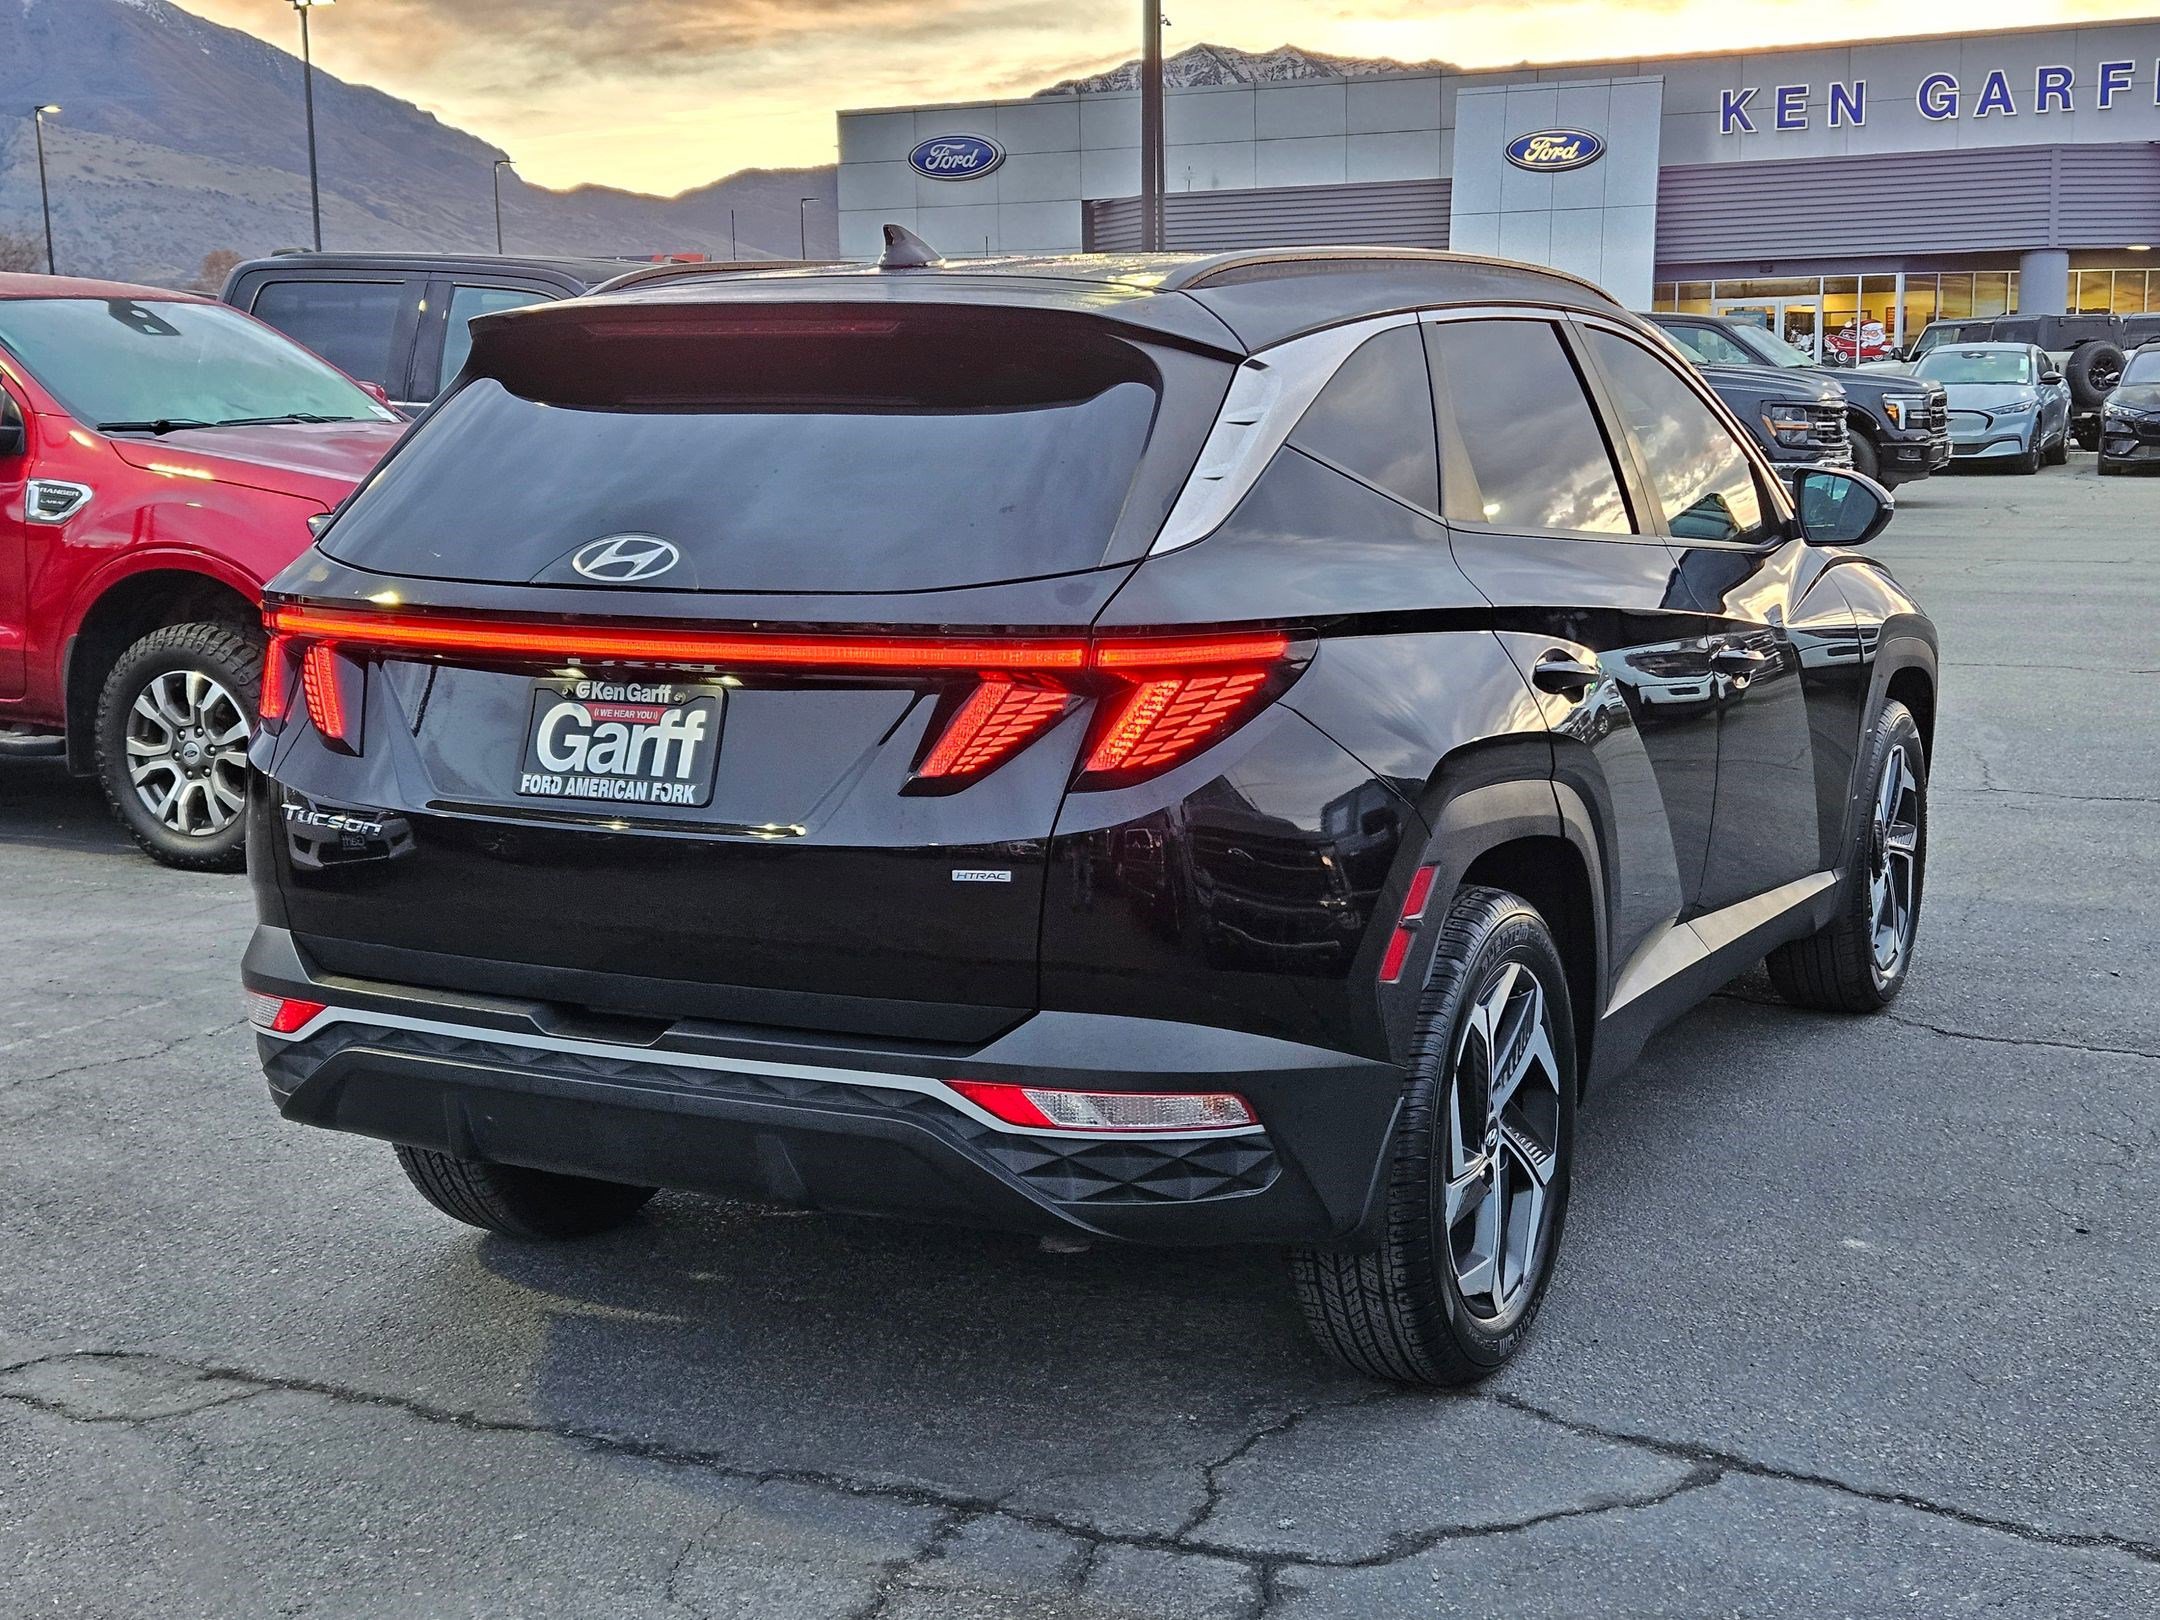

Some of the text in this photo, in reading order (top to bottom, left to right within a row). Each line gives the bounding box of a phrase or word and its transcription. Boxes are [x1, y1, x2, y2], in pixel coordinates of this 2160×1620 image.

[1719, 79, 1868, 135] KEN
[925, 143, 979, 170] Ford
[1523, 136, 1581, 161] Ford
[40, 486, 80, 497] RANGER
[591, 681, 625, 701] Ken
[626, 683, 672, 704] Garff
[600, 709, 654, 720] WE HEAR YOU
[536, 702, 706, 779] Garff
[520, 774, 697, 804] FORD AMERICAN FORK
[956, 872, 1007, 881] HTRAC
